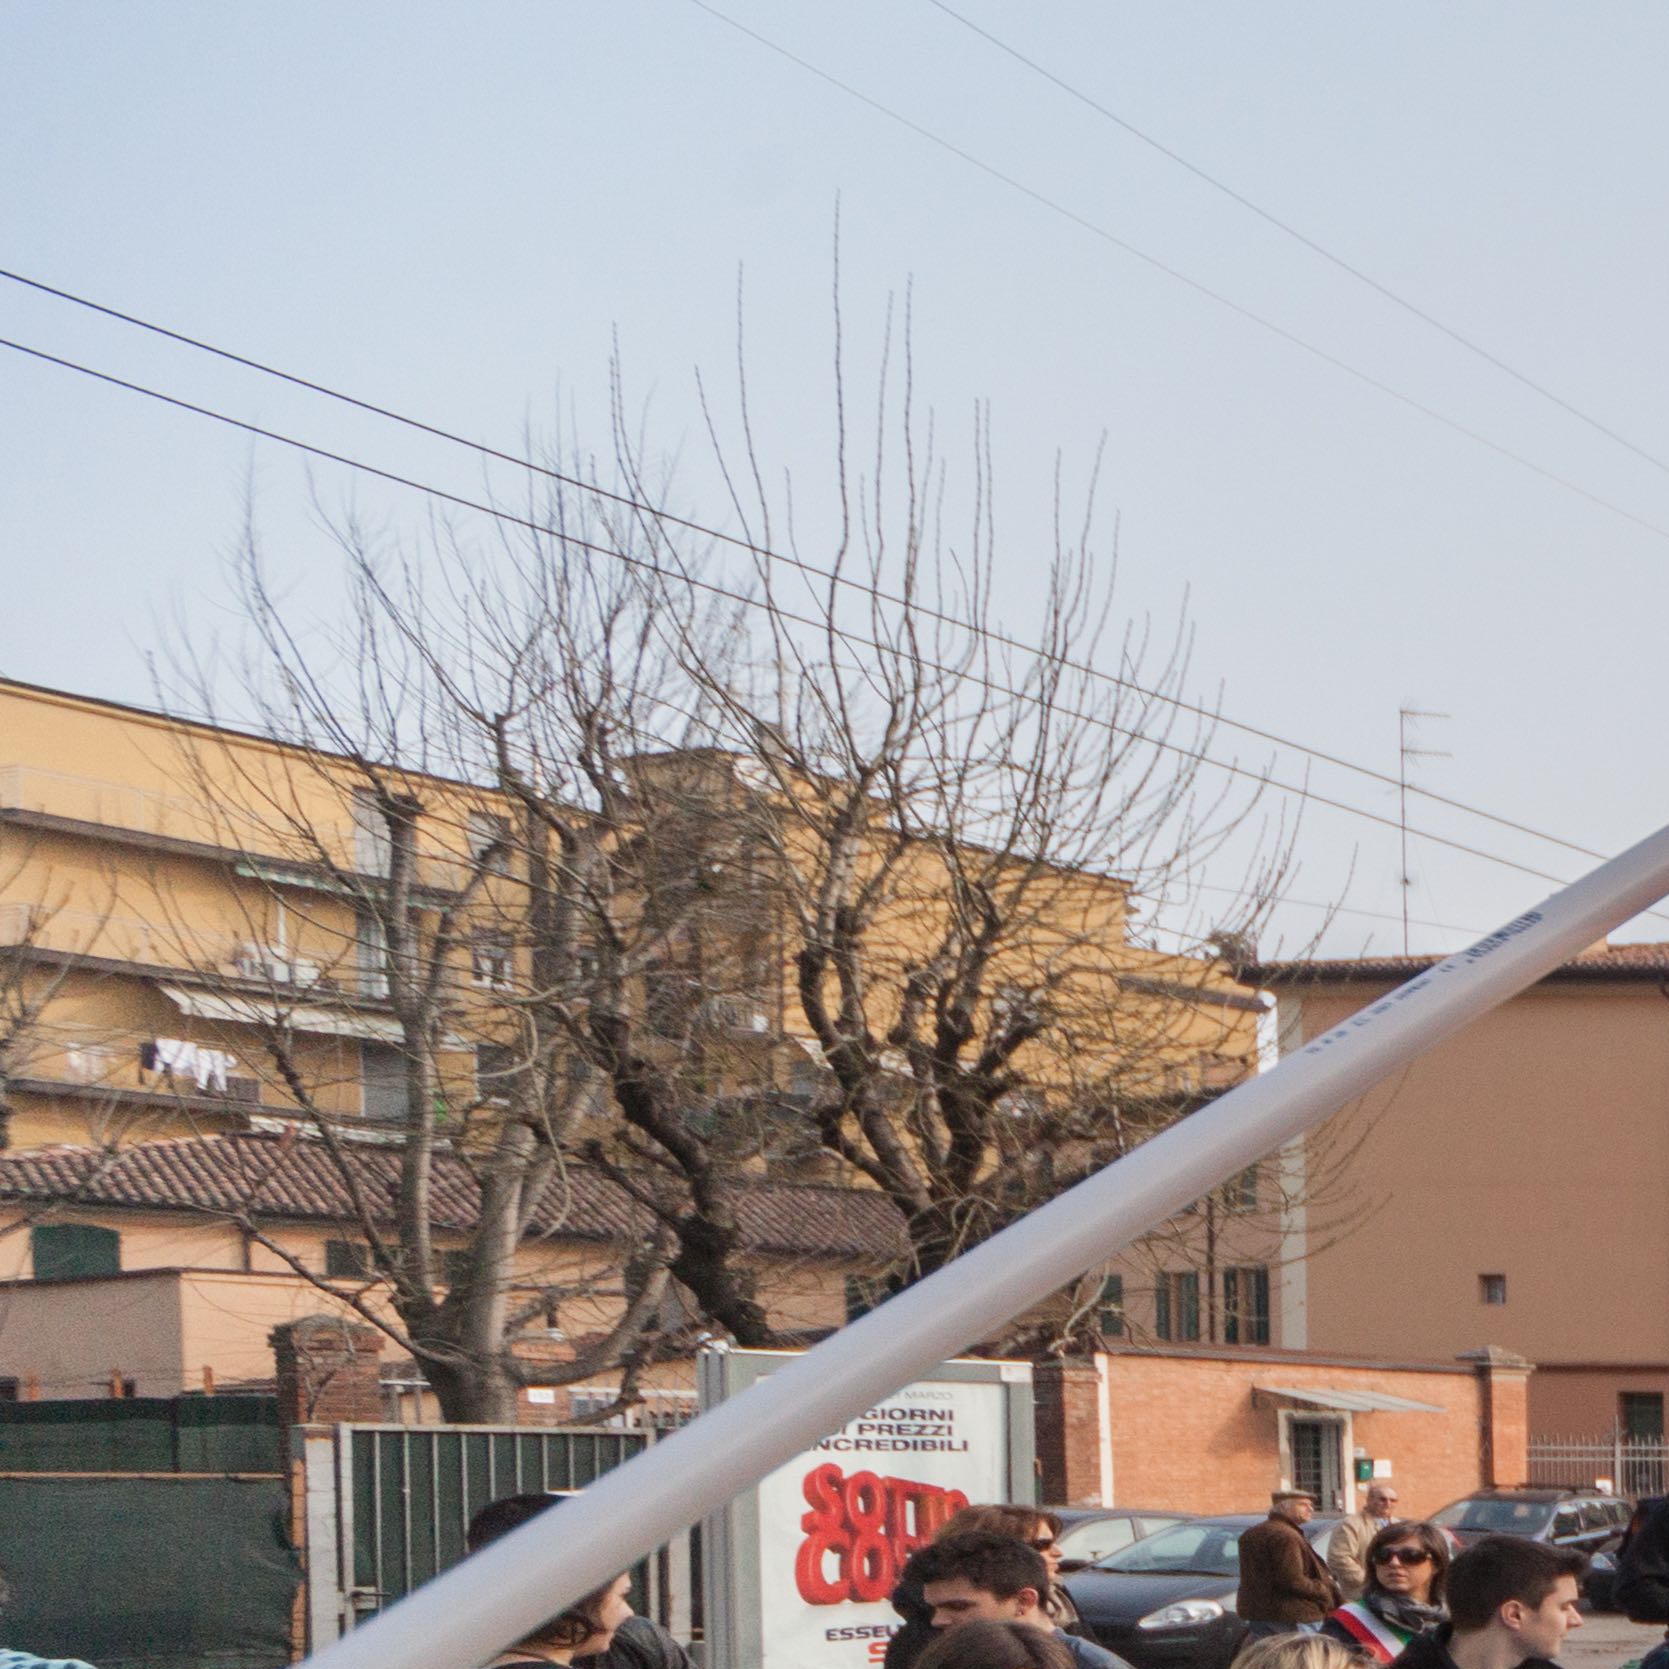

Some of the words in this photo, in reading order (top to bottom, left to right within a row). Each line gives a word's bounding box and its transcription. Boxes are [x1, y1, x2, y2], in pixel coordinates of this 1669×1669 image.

[860, 1407, 954, 1421] GIORNI
[858, 1423, 953, 1436] PREZZI
[812, 1439, 969, 1452] NCREDIBILI
